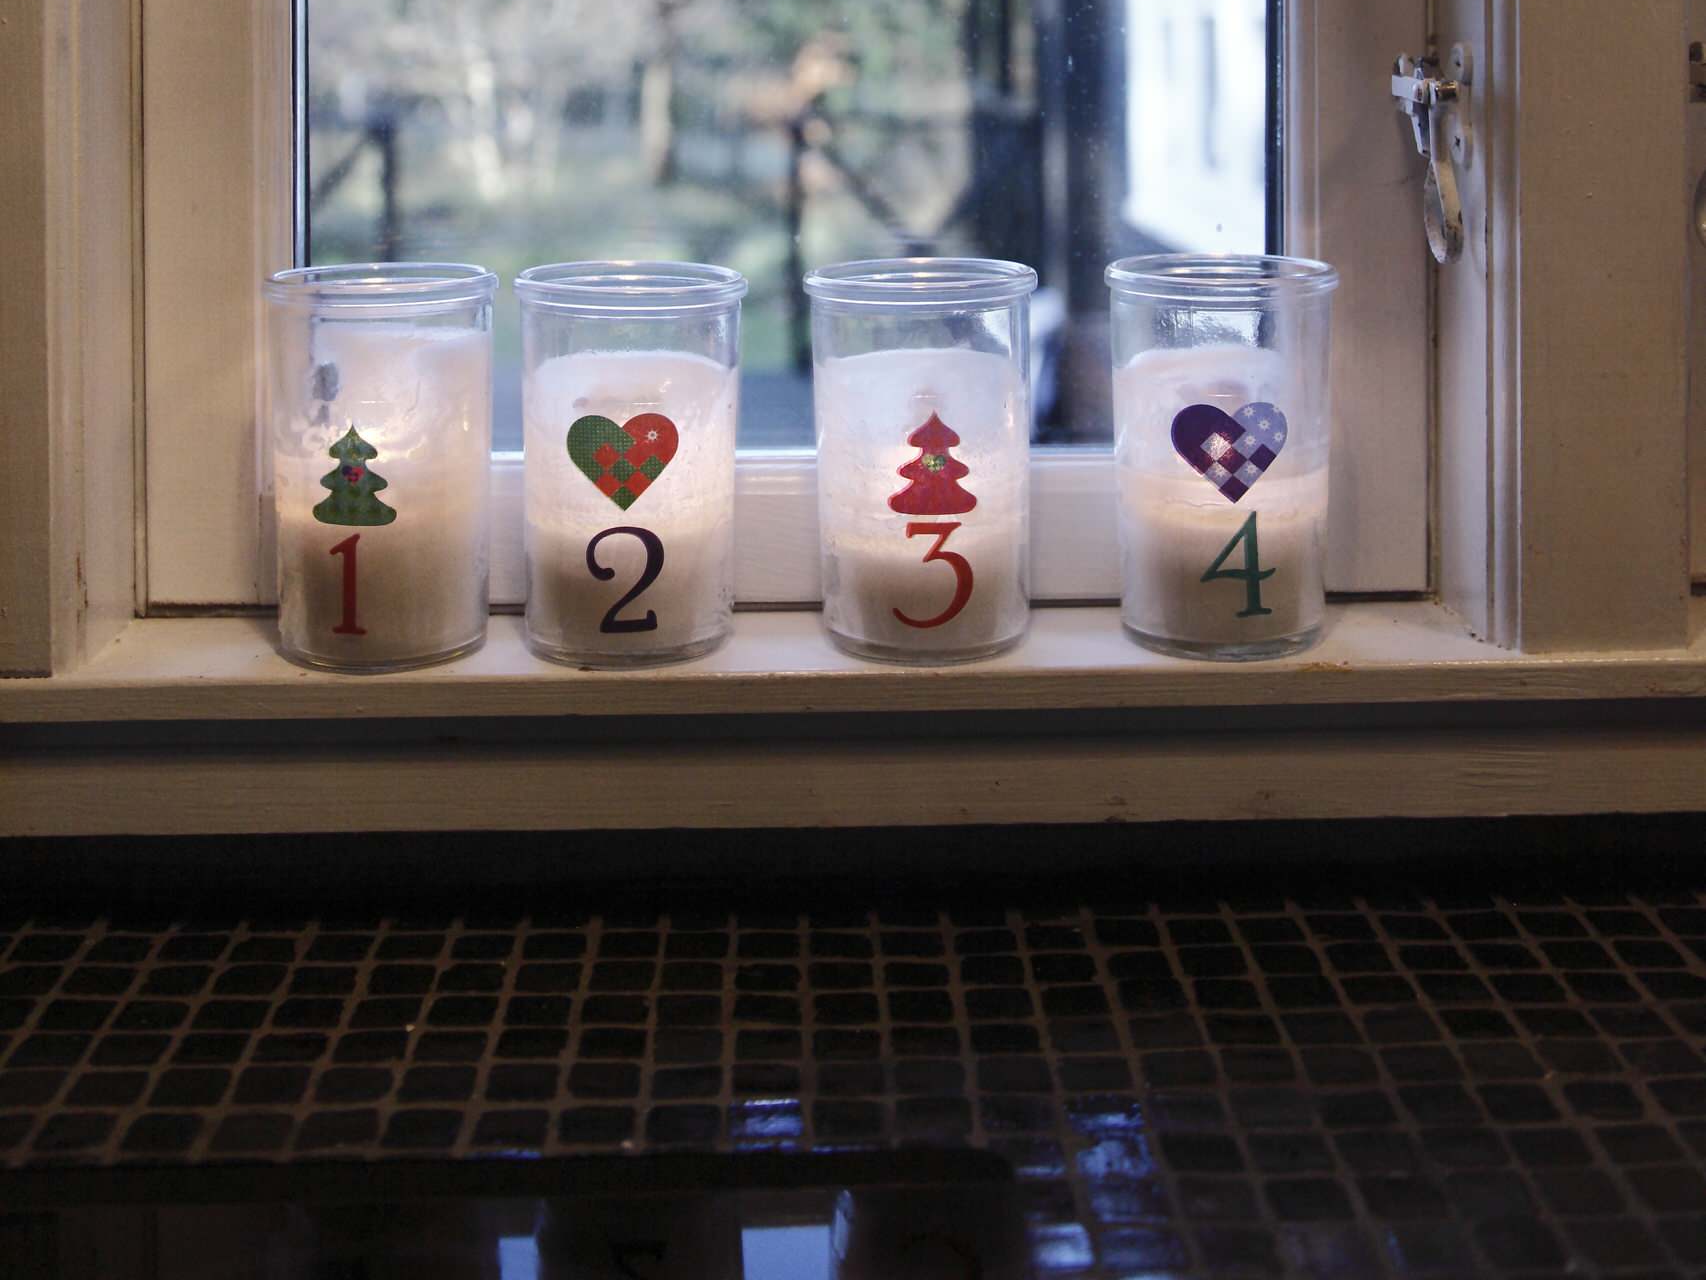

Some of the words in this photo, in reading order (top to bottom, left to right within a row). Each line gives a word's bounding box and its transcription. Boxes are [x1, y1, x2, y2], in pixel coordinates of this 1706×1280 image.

[329, 532, 367, 635] 1
[586, 526, 665, 634] 2
[893, 521, 974, 628] 3
[1200, 510, 1276, 618] 4
